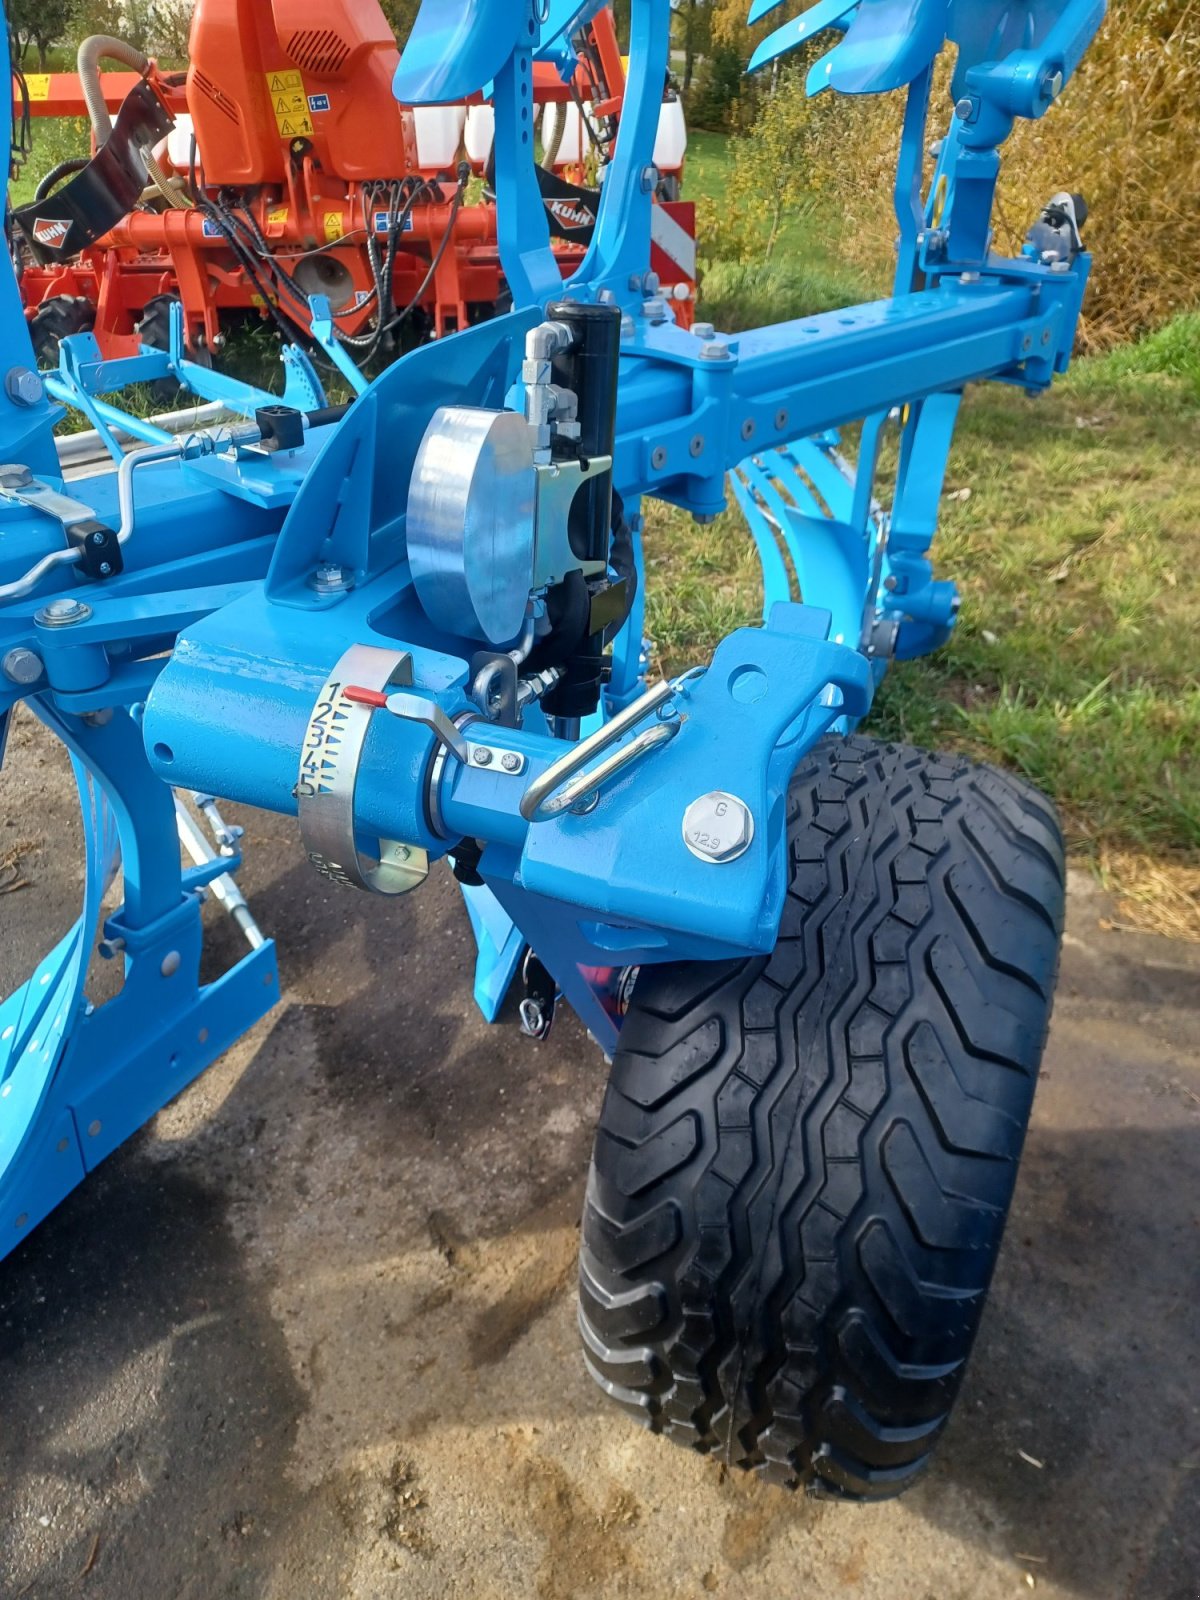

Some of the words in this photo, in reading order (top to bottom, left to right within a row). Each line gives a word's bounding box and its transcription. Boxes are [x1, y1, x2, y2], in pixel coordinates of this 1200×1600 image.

[551, 201, 591, 226] KUHN
[35, 222, 67, 242] KUHN
[329, 682, 341, 702] 1
[312, 703, 333, 725] 2
[307, 724, 326, 748] 3
[302, 751, 319, 774] 4
[299, 773, 315, 797] 5
[714, 802, 728, 817] G
[693, 831, 721, 850] 12.9
